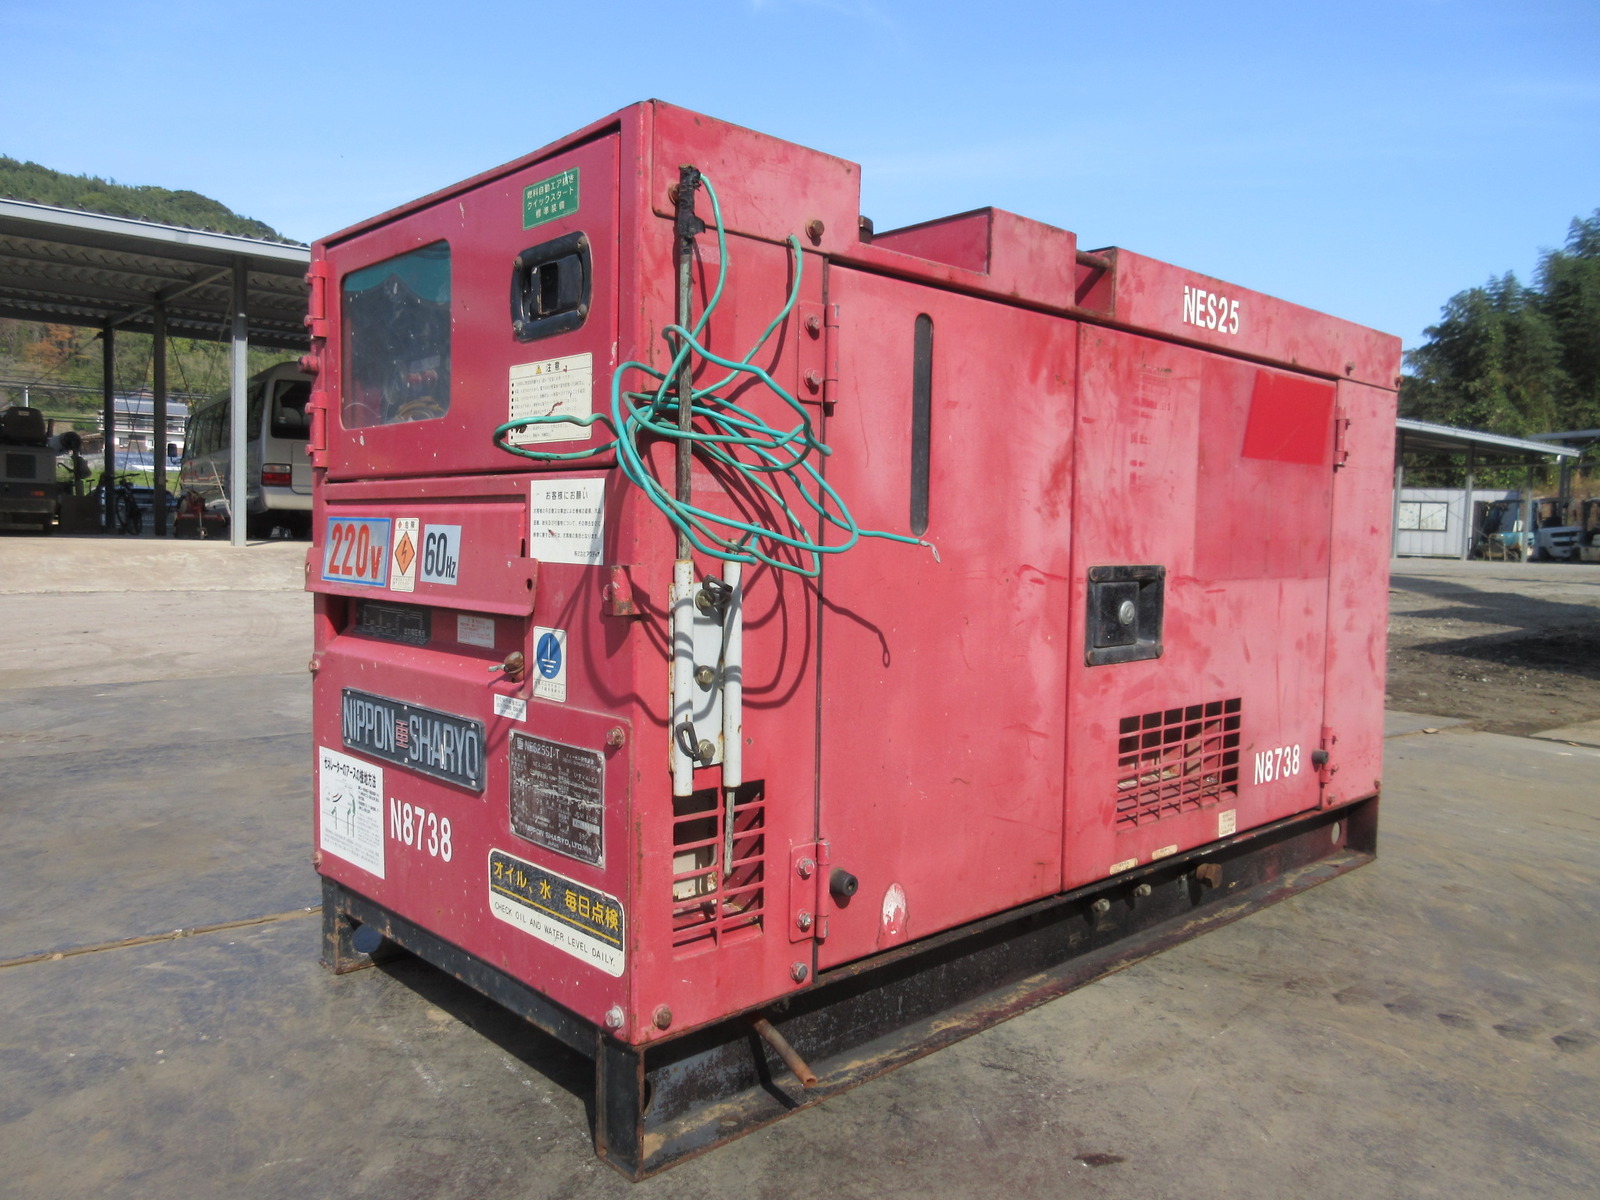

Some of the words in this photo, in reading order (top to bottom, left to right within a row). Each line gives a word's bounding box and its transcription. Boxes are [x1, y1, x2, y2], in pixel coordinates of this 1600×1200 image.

[528, 186, 574, 210] クイックスタート
[1183, 285, 1240, 335] NES25
[546, 361, 560, 373] 注意
[545, 490, 589, 500] お客様にお願い
[424, 532, 456, 578] 60Hz
[343, 696, 395, 753] NIPPON
[409, 714, 479, 779] SHARYO
[1254, 744, 1300, 785] N8738
[390, 797, 452, 862] N8738
[565, 889, 619, 931] 毎日点検
[494, 901, 512, 916] CHECK
[515, 911, 527, 924] OIL
[529, 918, 542, 930] AND
[543, 925, 564, 942] WATER
[567, 936, 588, 953] LEVEL
[592, 948, 616, 967] DAILY.
